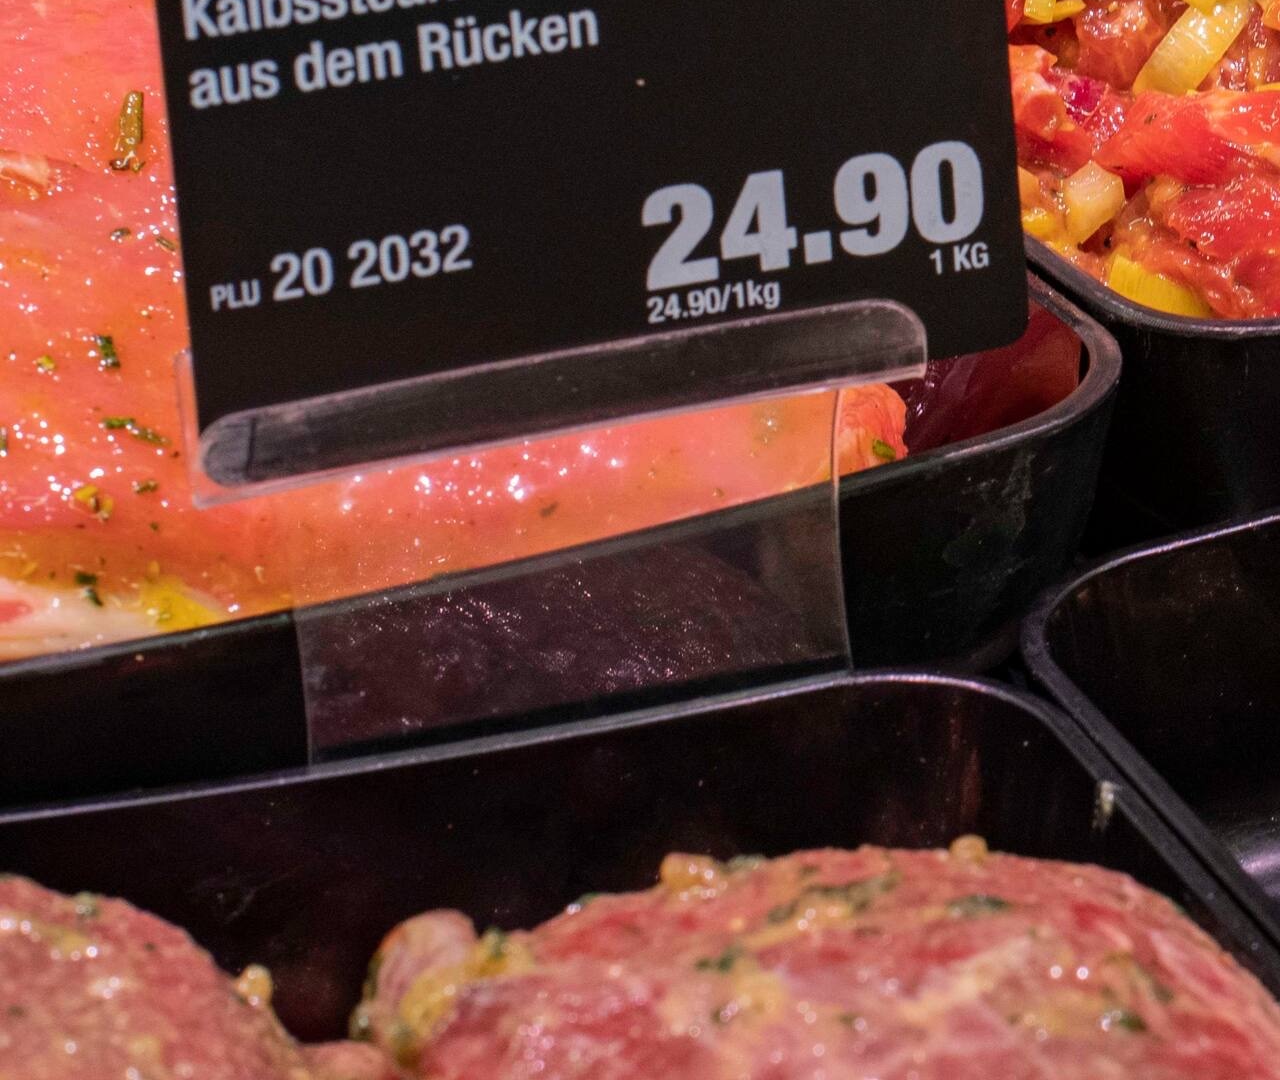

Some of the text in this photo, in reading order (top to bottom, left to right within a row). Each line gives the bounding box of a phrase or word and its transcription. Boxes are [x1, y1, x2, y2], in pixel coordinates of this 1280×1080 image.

[189, 9, 599, 109] aus dem Rücken
[641, 140, 984, 292] 24.90
[929, 241, 990, 275] 1 KG
[210, 224, 473, 311] PLU 20 2032
[646, 279, 781, 324] 24.90/1kg
